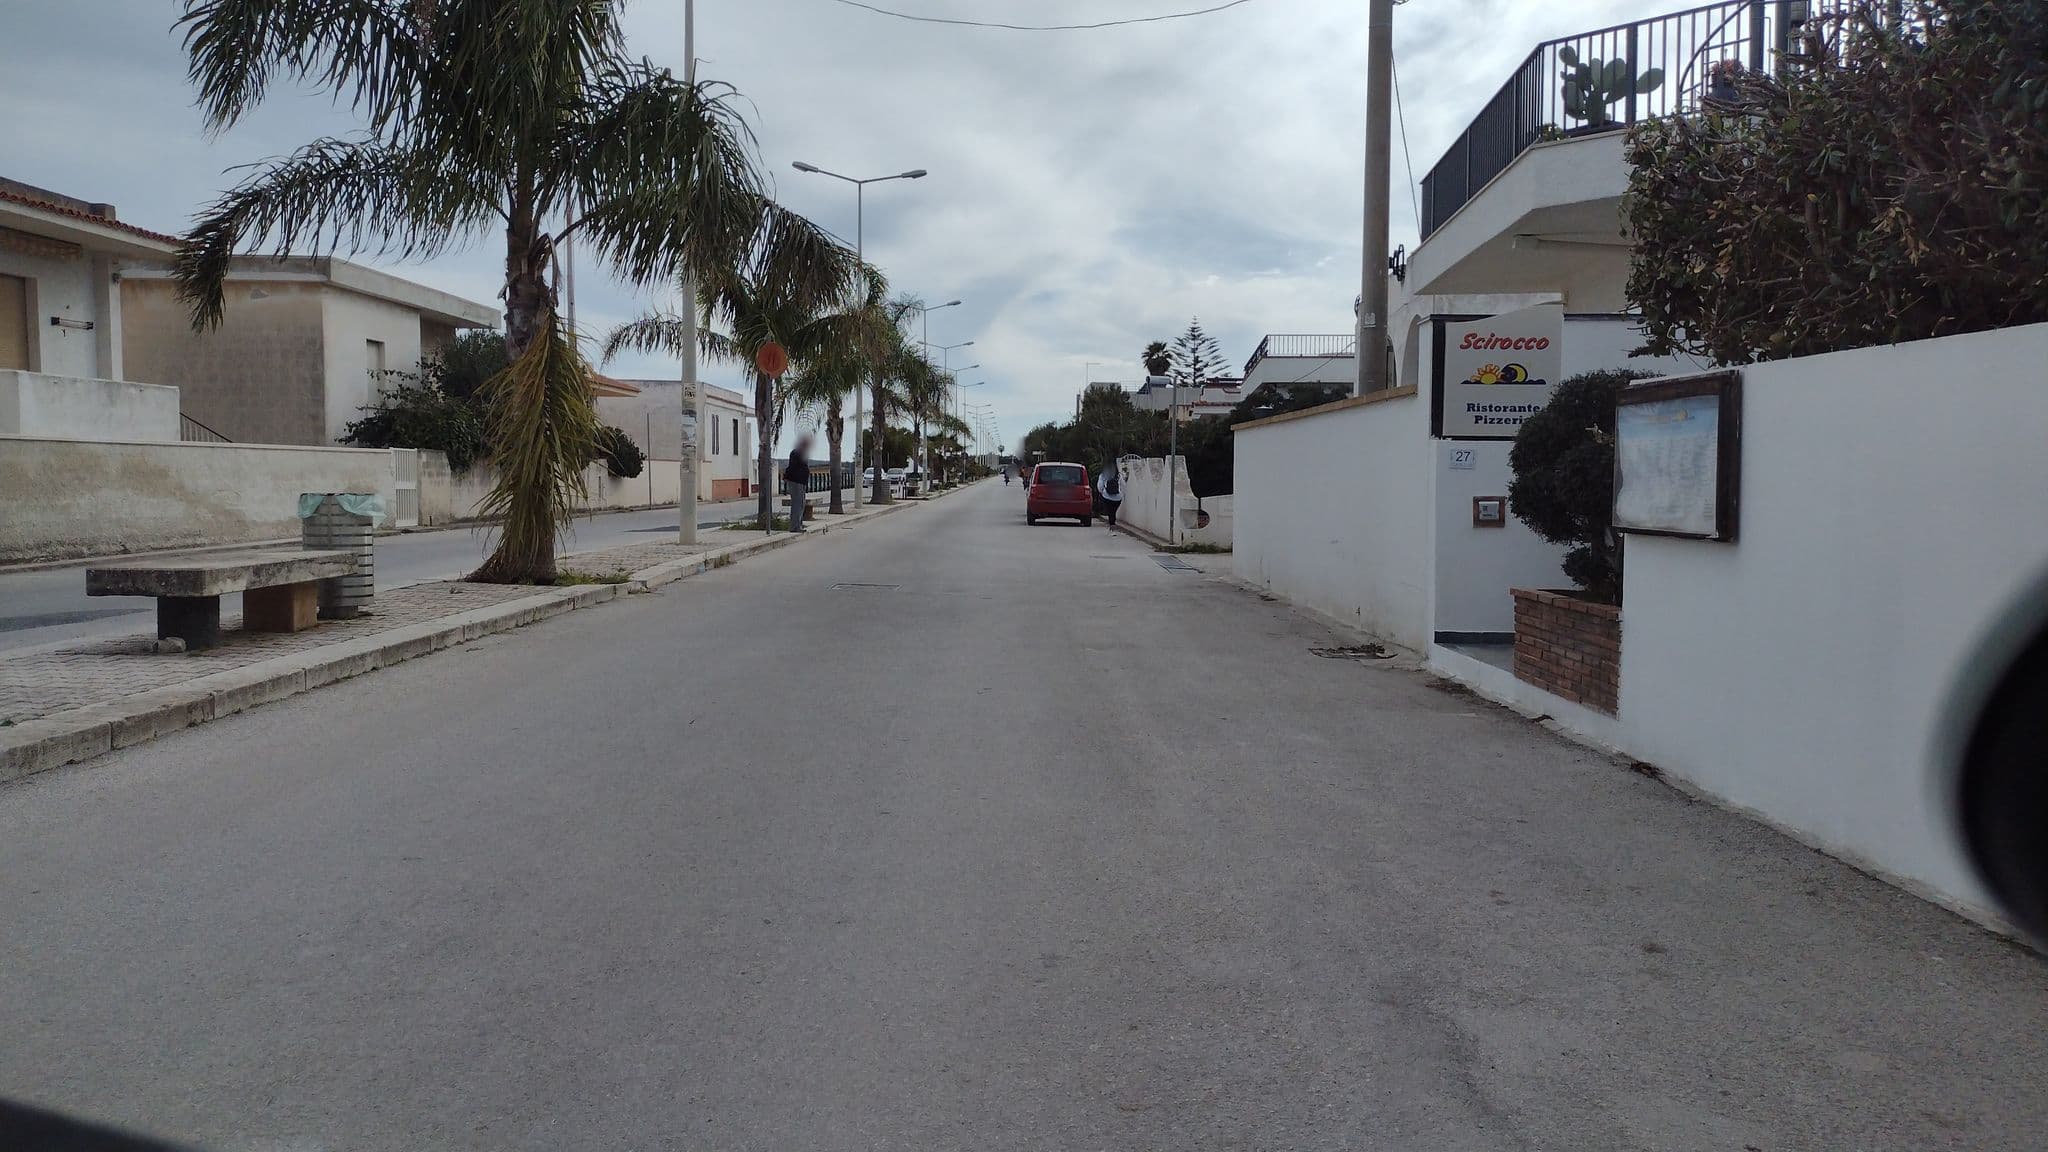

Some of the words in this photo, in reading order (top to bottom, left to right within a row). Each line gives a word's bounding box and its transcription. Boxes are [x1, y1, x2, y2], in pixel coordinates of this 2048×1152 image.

[1460, 332, 1550, 350] Scirocco
[1467, 403, 1541, 412] Ristorante
[1474, 415, 1524, 424] Pizzeri
[1456, 451, 1471, 462] 27
